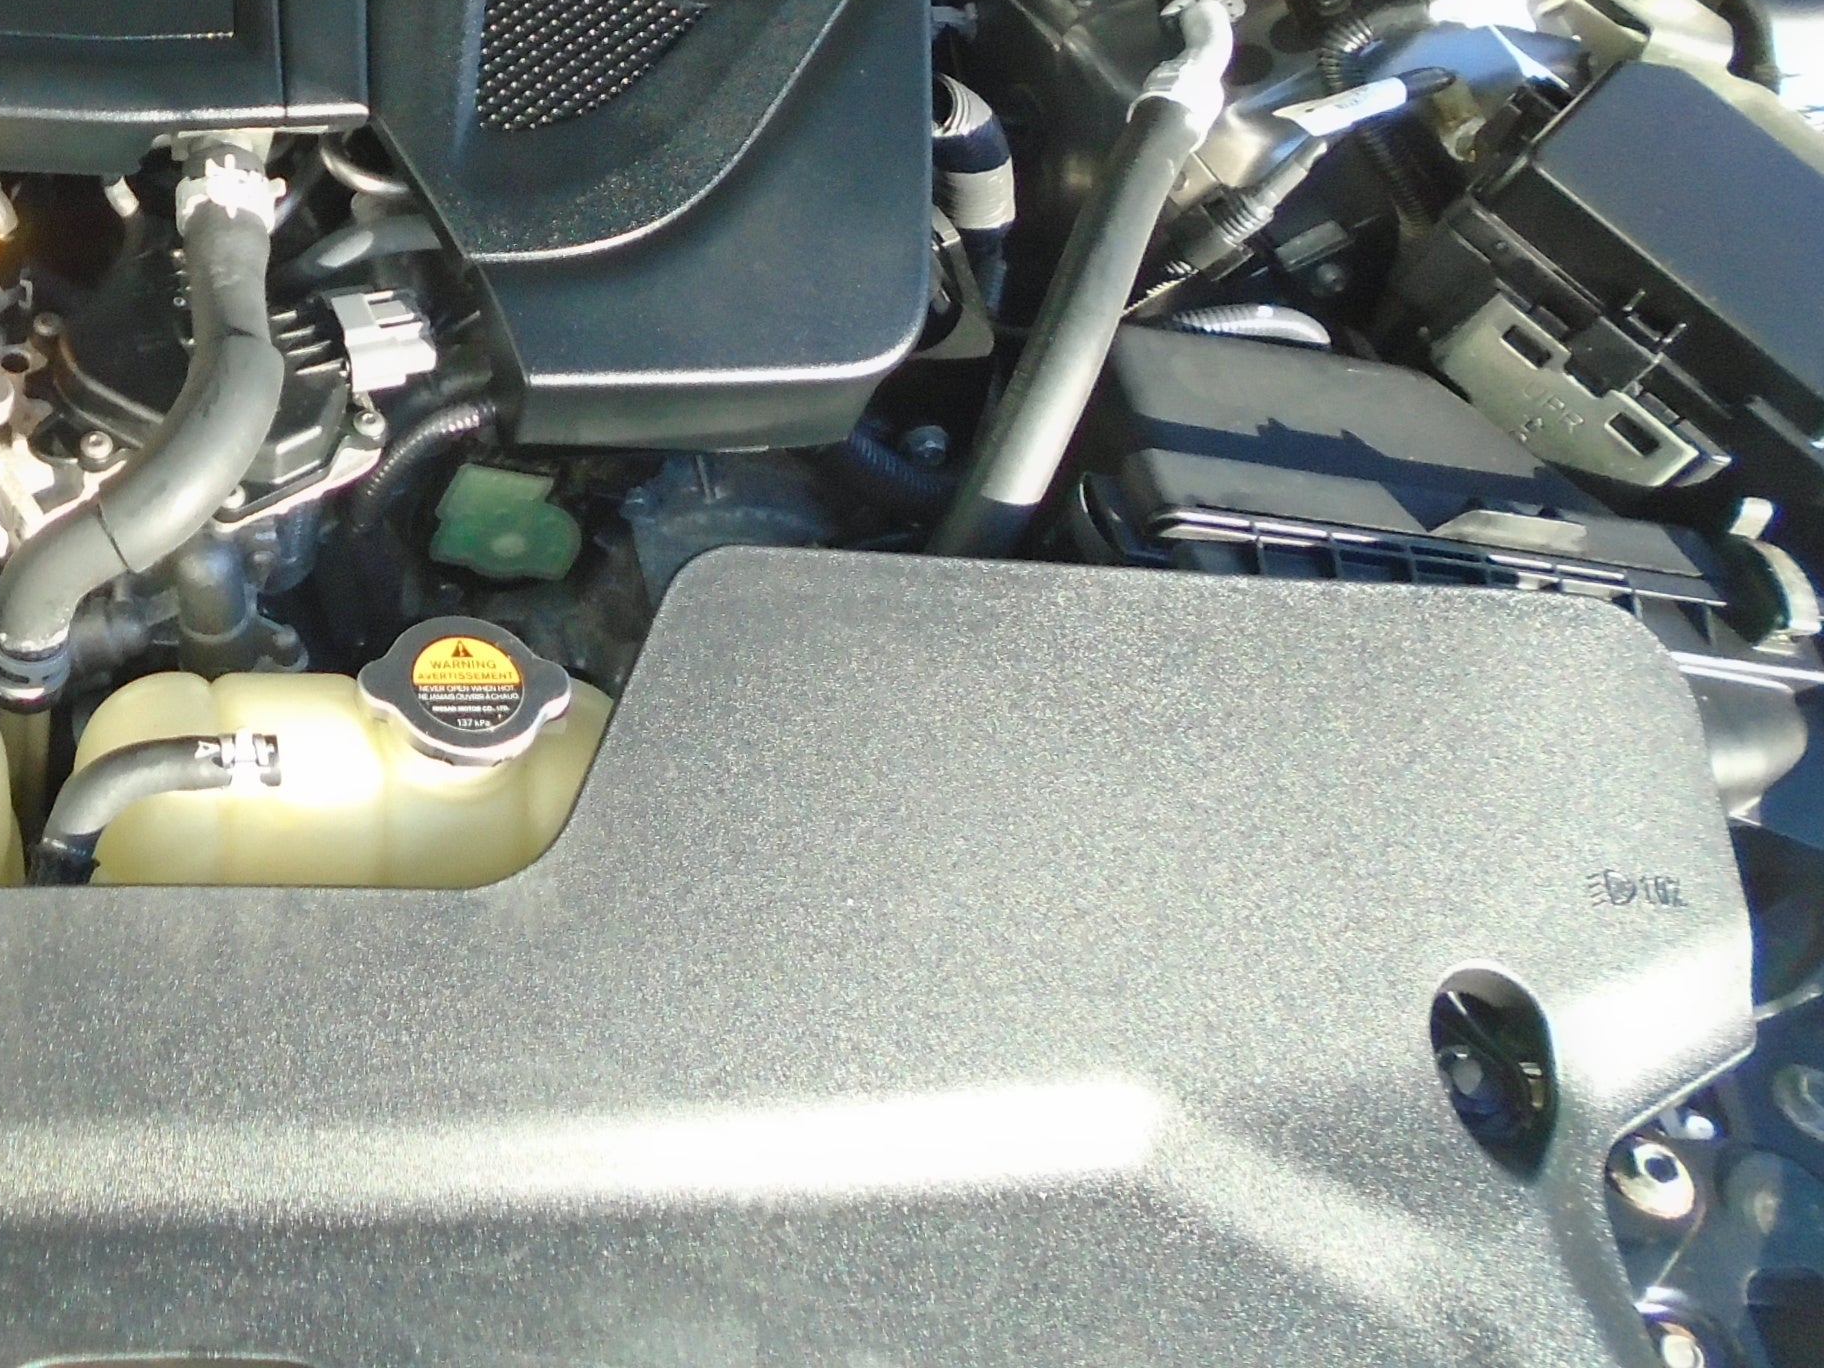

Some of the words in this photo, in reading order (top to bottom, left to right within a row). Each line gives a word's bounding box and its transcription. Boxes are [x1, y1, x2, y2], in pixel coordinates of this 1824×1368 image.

[429, 659, 497, 670] WARNING
[417, 671, 513, 681] AVERTISSEMENT
[418, 684, 445, 692] NEVER
[446, 684, 470, 692] OPEN
[471, 684, 496, 692] WHEN
[457, 718, 472, 727] 137
